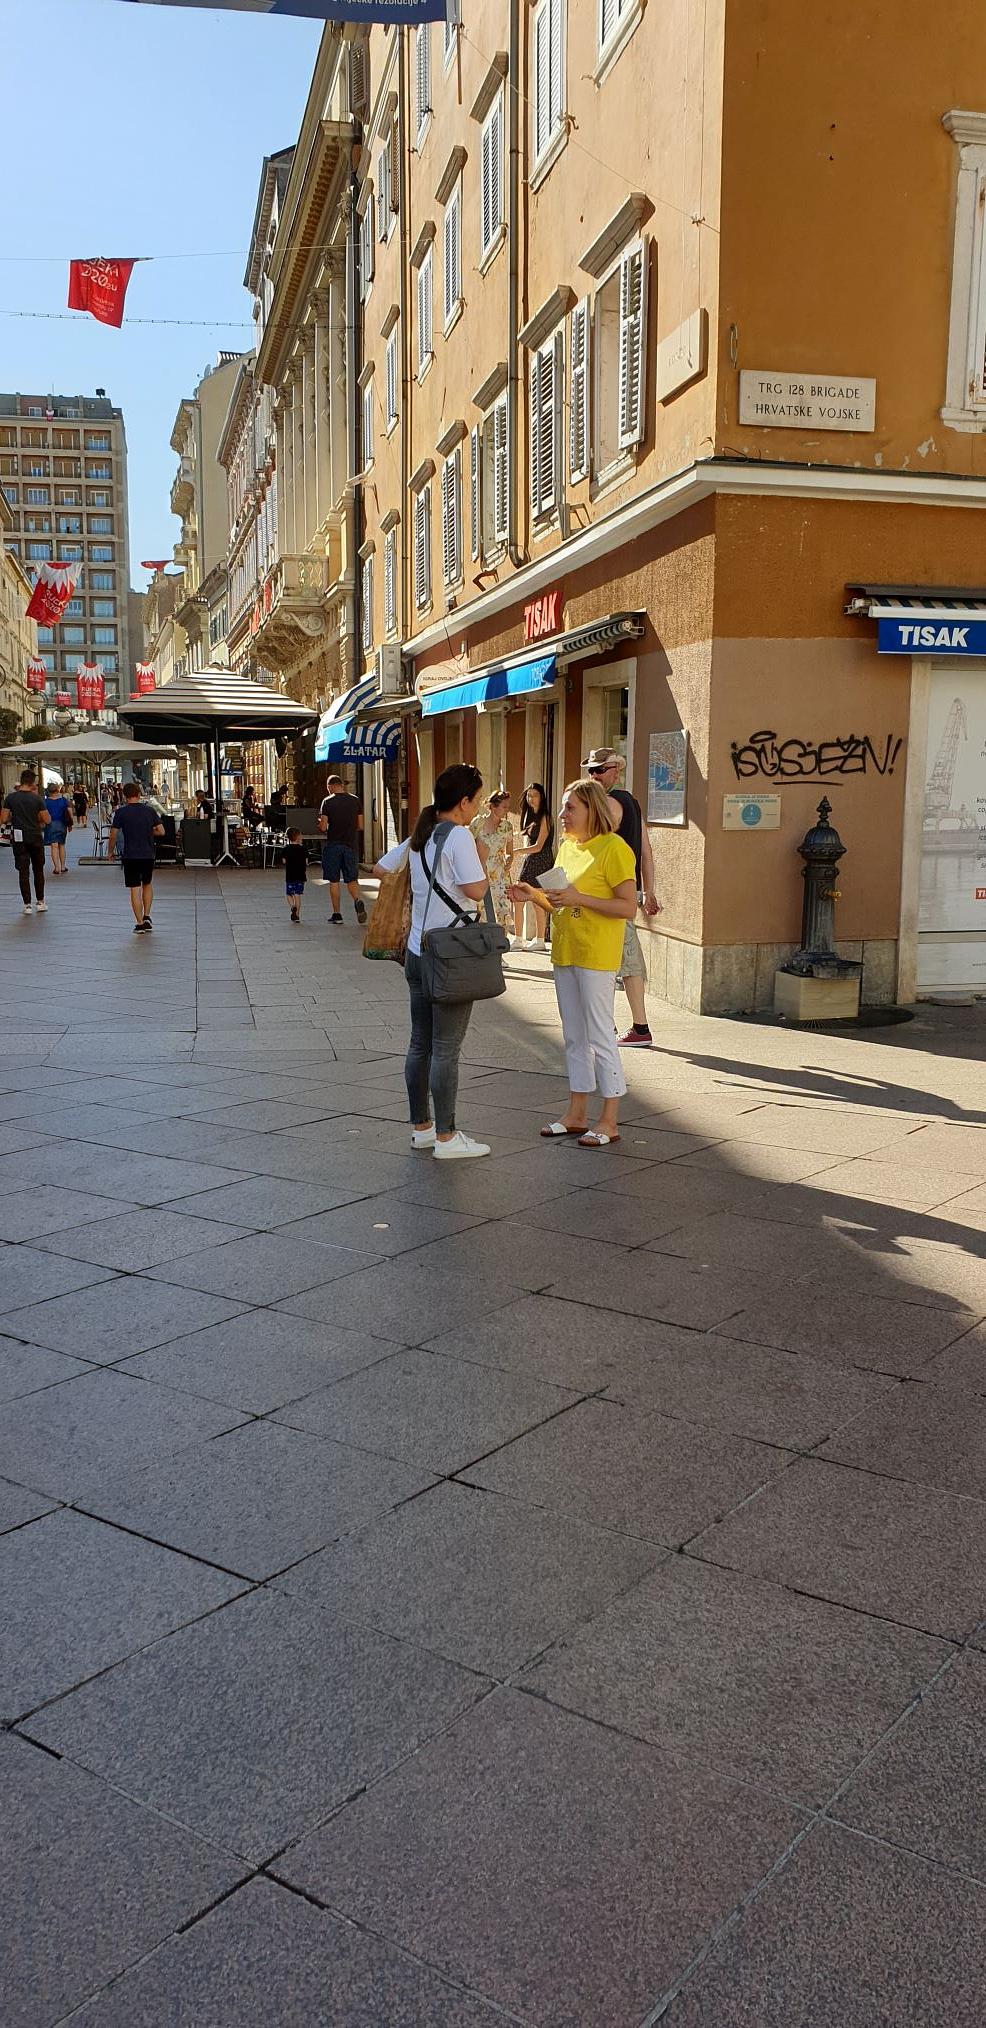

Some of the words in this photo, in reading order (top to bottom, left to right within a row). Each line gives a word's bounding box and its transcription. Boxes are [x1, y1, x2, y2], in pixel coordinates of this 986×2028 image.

[758, 382, 783, 395] TRG
[789, 384, 805, 396] 128
[811, 386, 861, 399] BRIGADE
[755, 403, 813, 417] HRVATSKE
[819, 407, 861, 420] VOJSKE
[524, 590, 559, 640] TISAK
[898, 625, 970, 648] TISAK
[343, 745, 387, 758] ZLATAR
